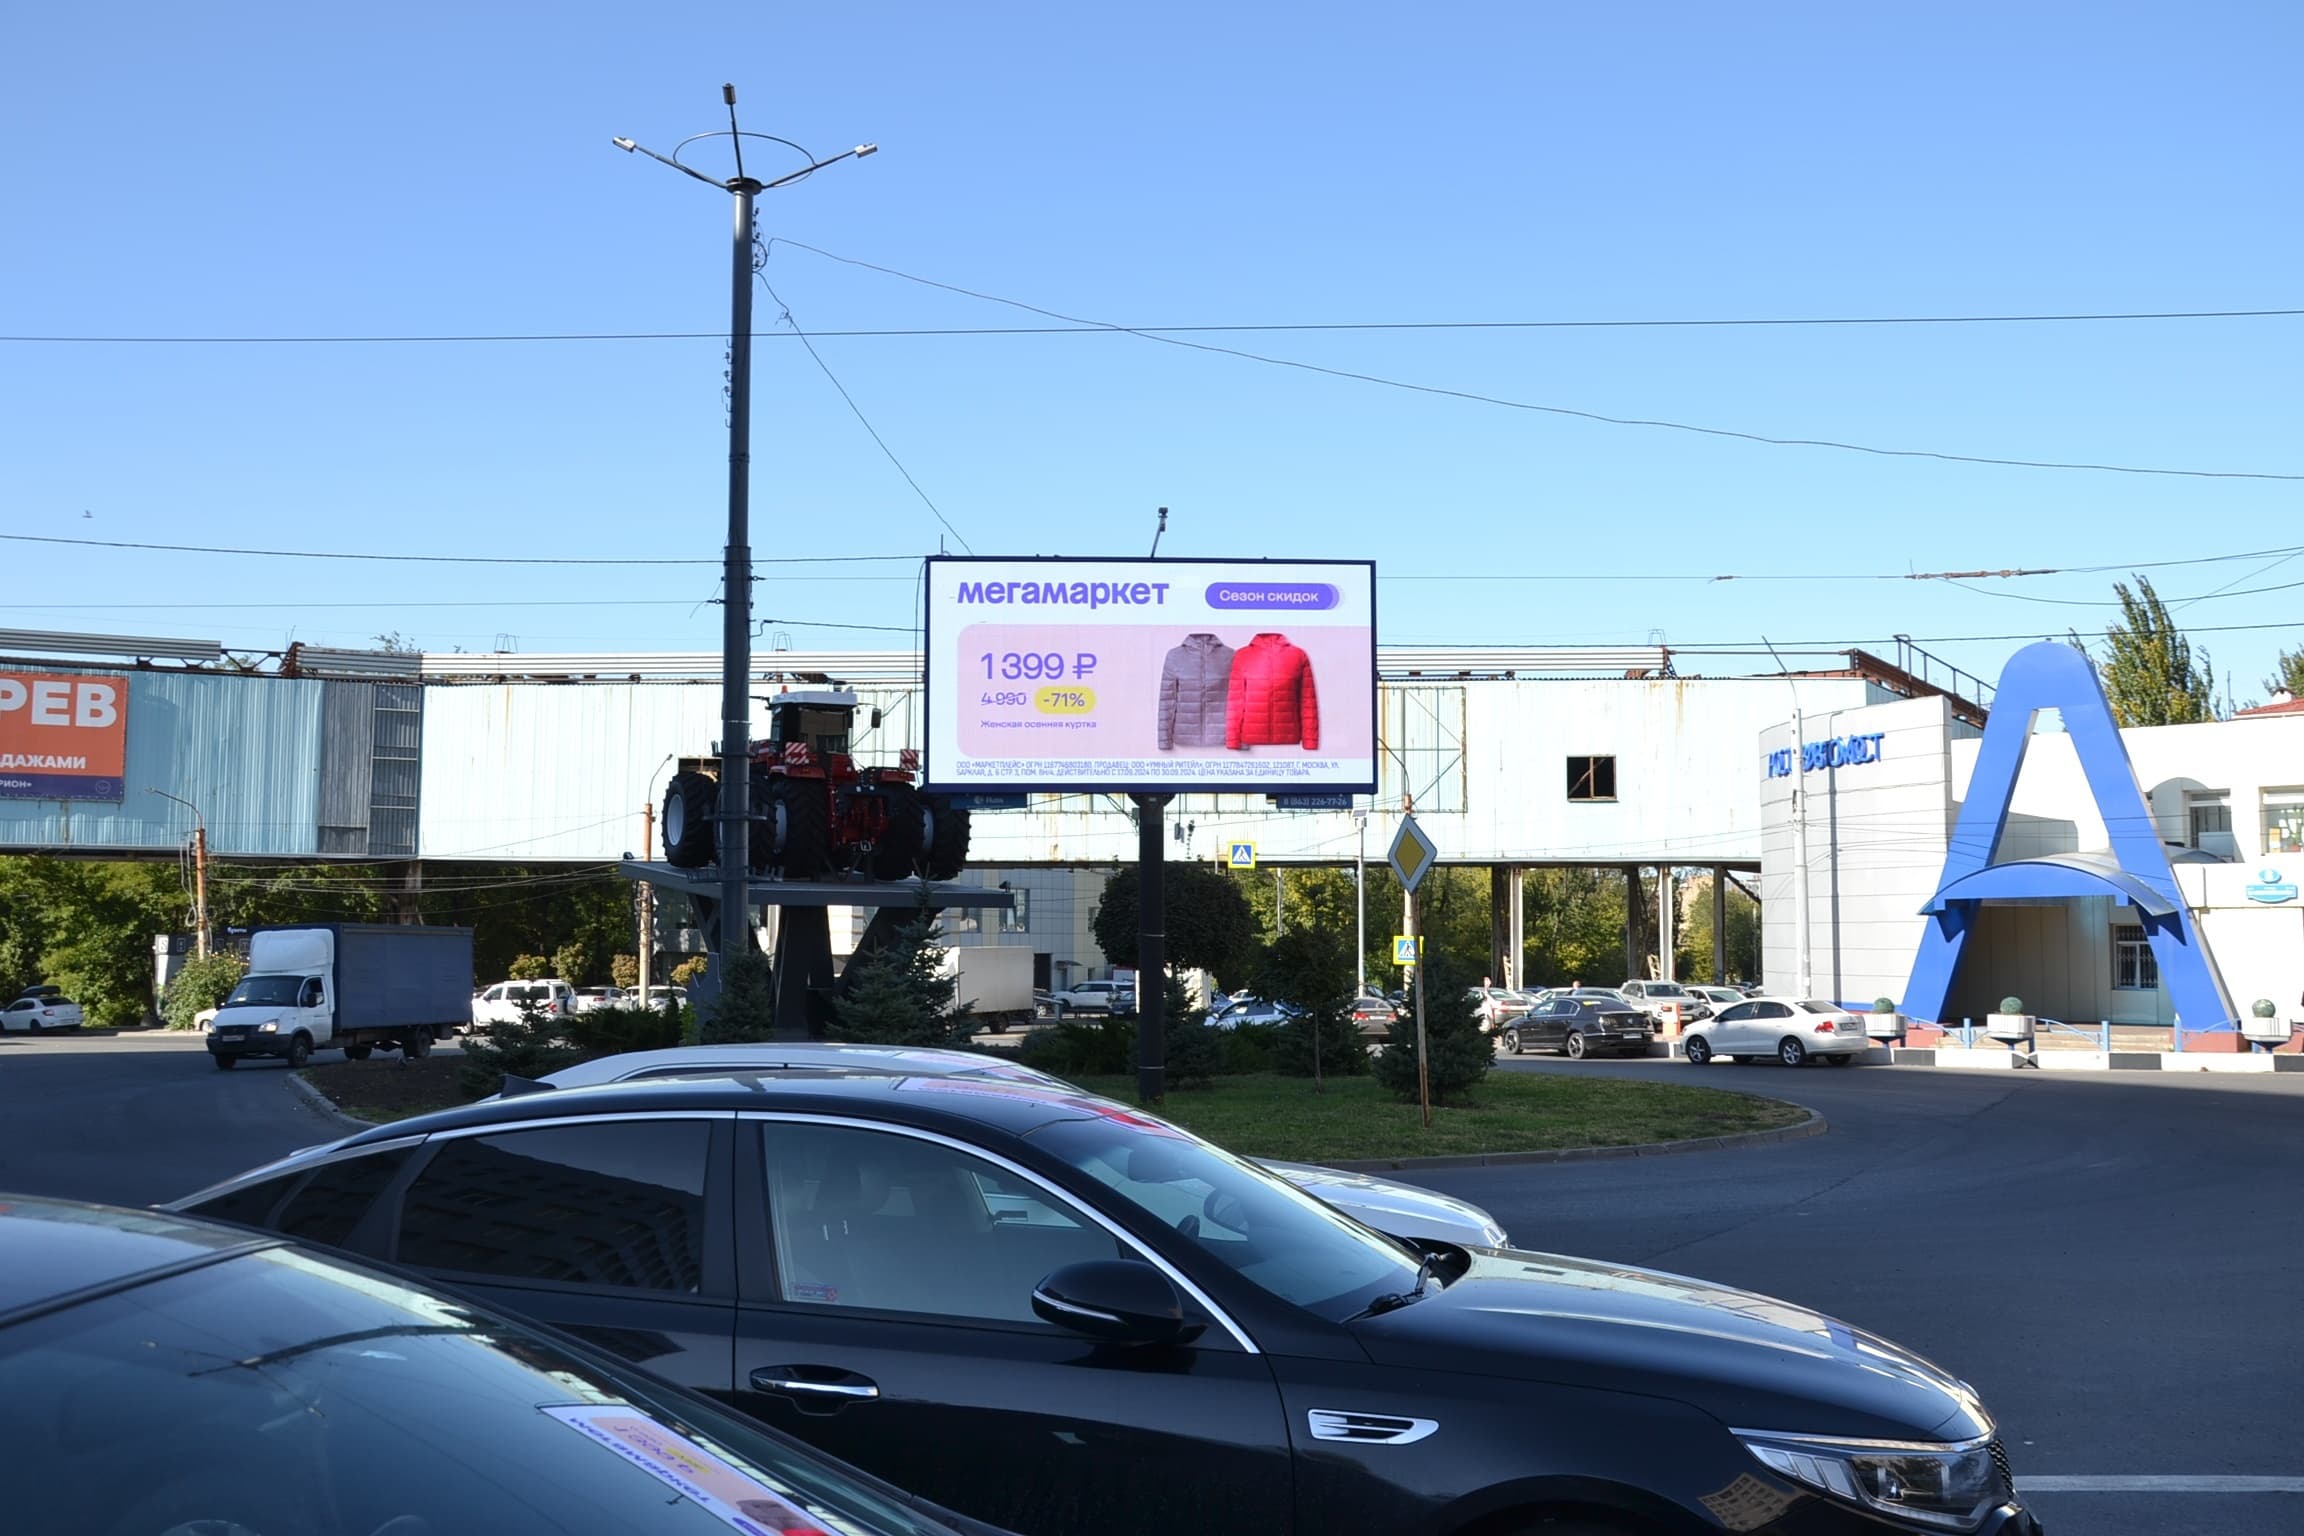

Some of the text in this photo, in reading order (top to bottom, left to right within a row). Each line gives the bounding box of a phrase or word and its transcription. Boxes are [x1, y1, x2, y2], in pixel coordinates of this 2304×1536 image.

[957, 582, 1170, 610] мегамаркет
[1219, 589, 1319, 604] Сезон скидок
[1043, 692, 1086, 707] -71%
[980, 720, 1097, 730] Женская осенняя куртка
[956, 760, 970, 769] ООО
